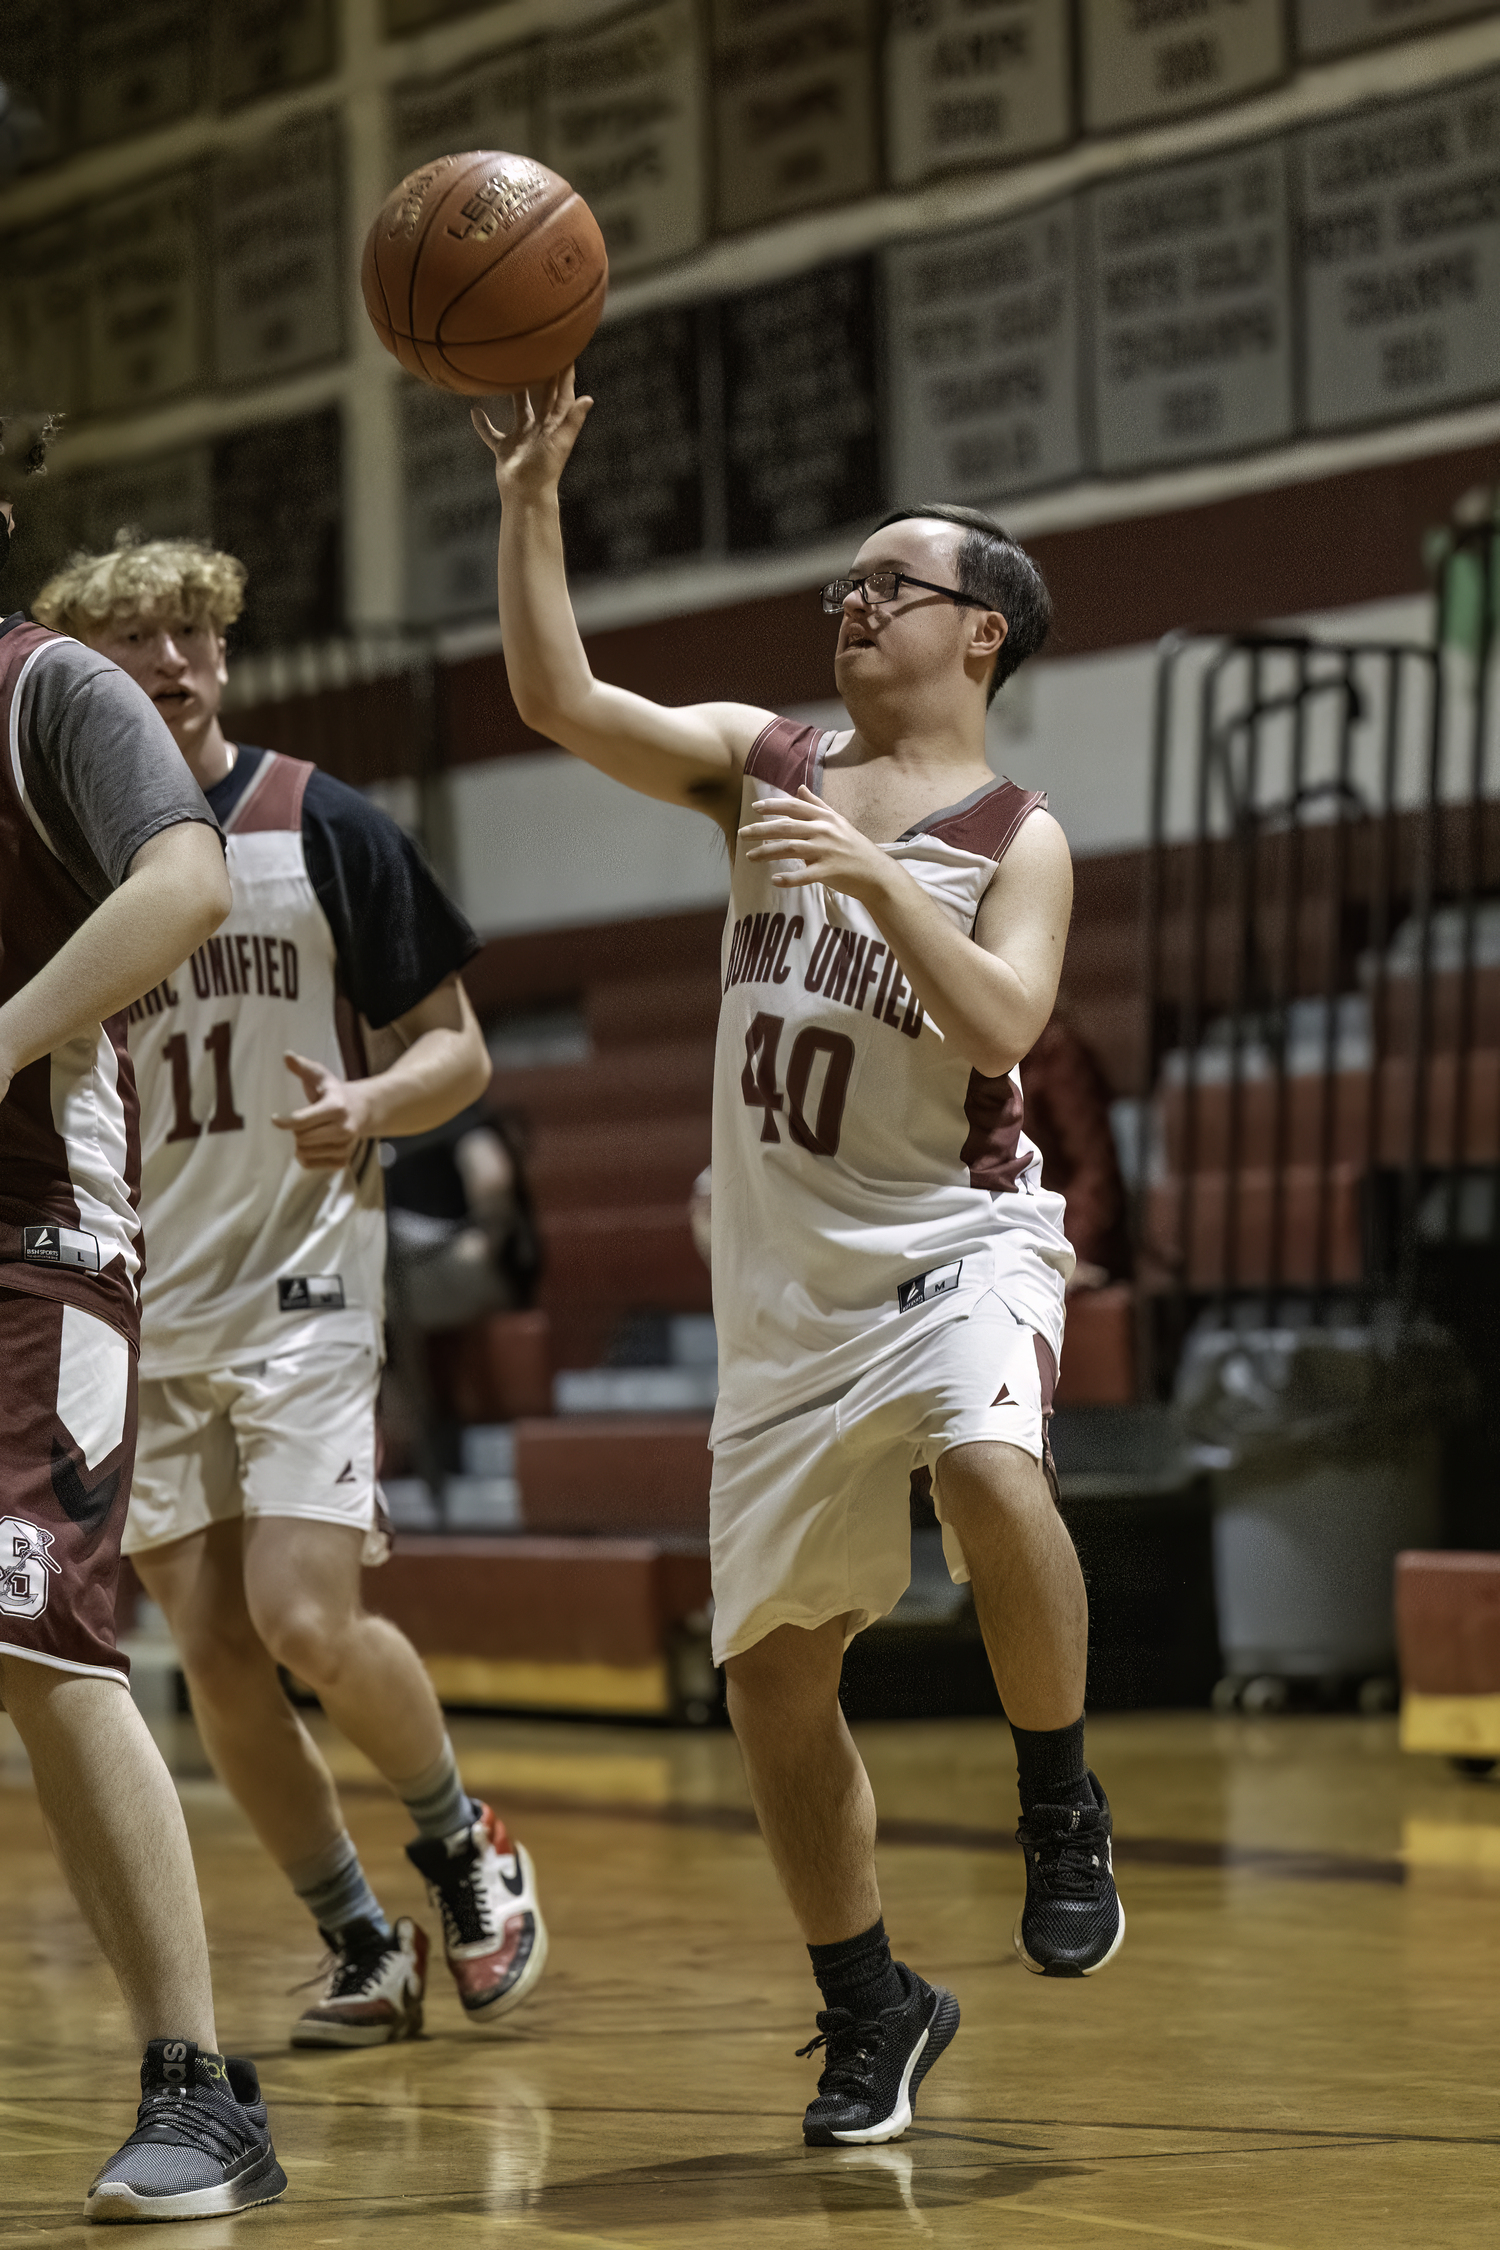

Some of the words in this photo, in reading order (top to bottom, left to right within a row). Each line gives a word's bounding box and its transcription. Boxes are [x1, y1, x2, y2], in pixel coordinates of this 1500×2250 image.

[191, 934, 299, 1001] UNIFIED
[162, 1022, 245, 1144] 11
[741, 1011, 856, 1158] 40
[77, 1251, 85, 1262] L
[934, 1280, 946, 1292] M
